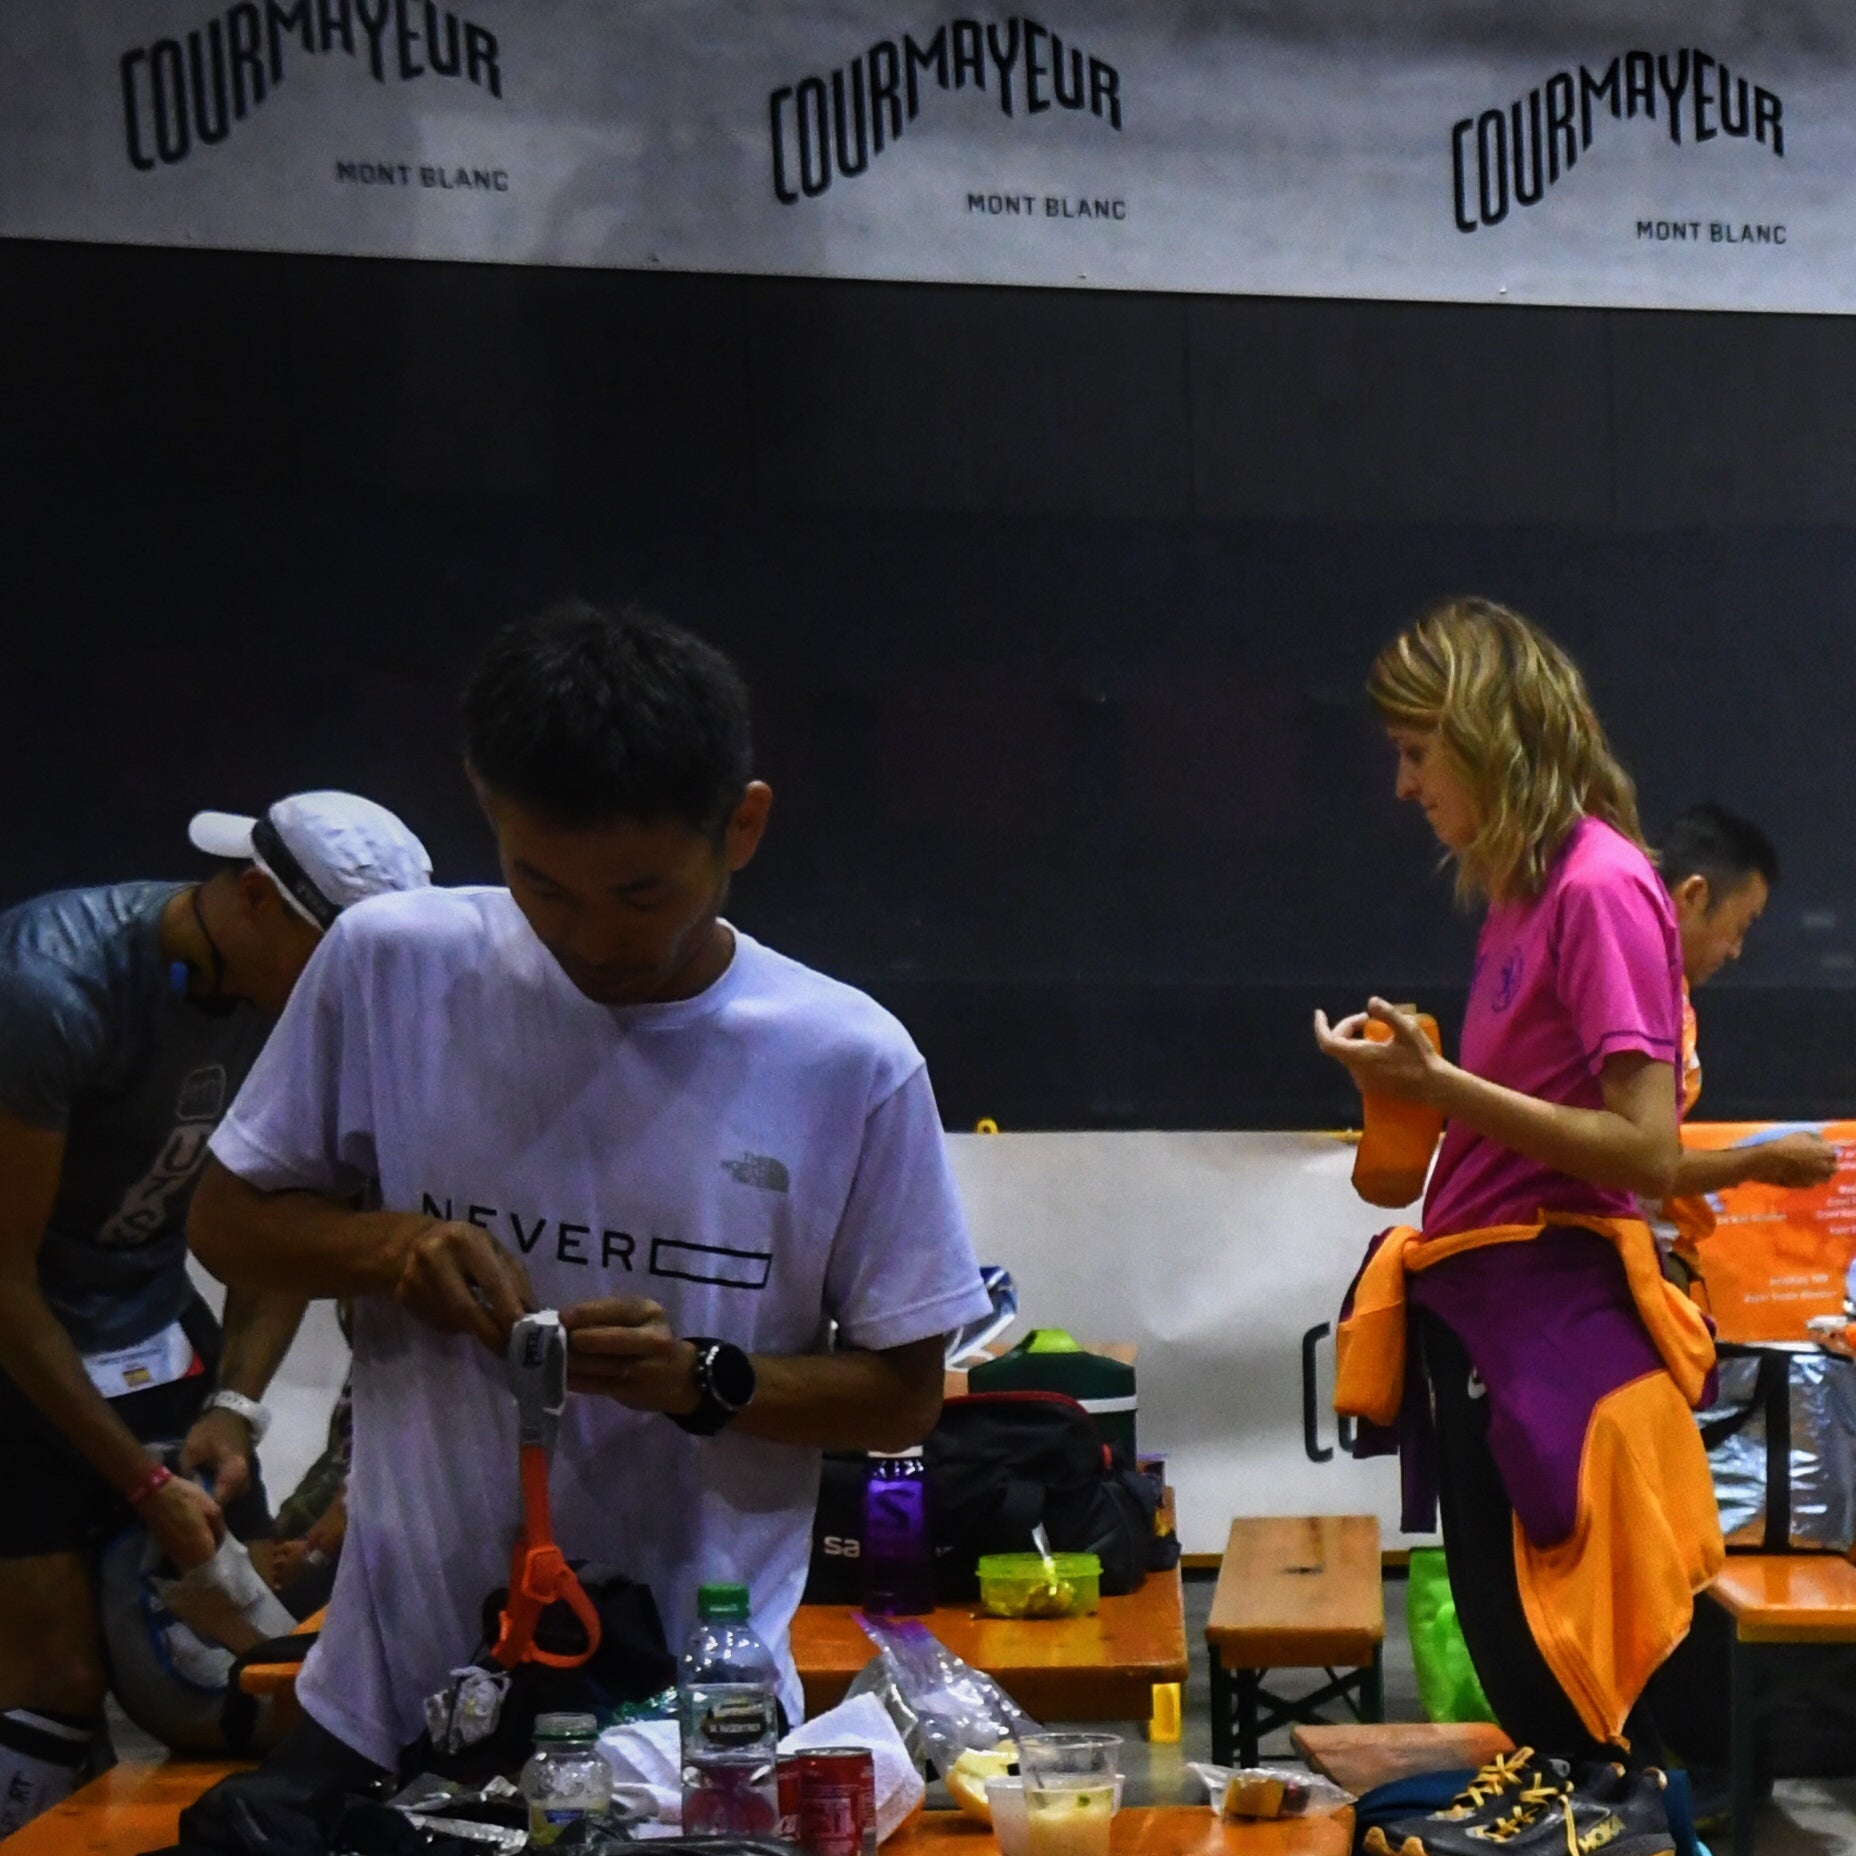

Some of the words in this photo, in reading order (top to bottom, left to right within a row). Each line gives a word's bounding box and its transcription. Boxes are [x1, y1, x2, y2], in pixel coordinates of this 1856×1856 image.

[120, 0, 504, 172] COURMAYEUR
[769, 16, 1124, 205] COURMAYEUR
[334, 159, 410, 188] MONT
[421, 166, 510, 193] BLANC
[1450, 47, 1785, 234] COURMAYEUR
[967, 193, 1033, 217] MONT
[1044, 197, 1127, 222] BLANC
[1636, 219, 1702, 243] MONT
[1710, 222, 1788, 246] BLANC
